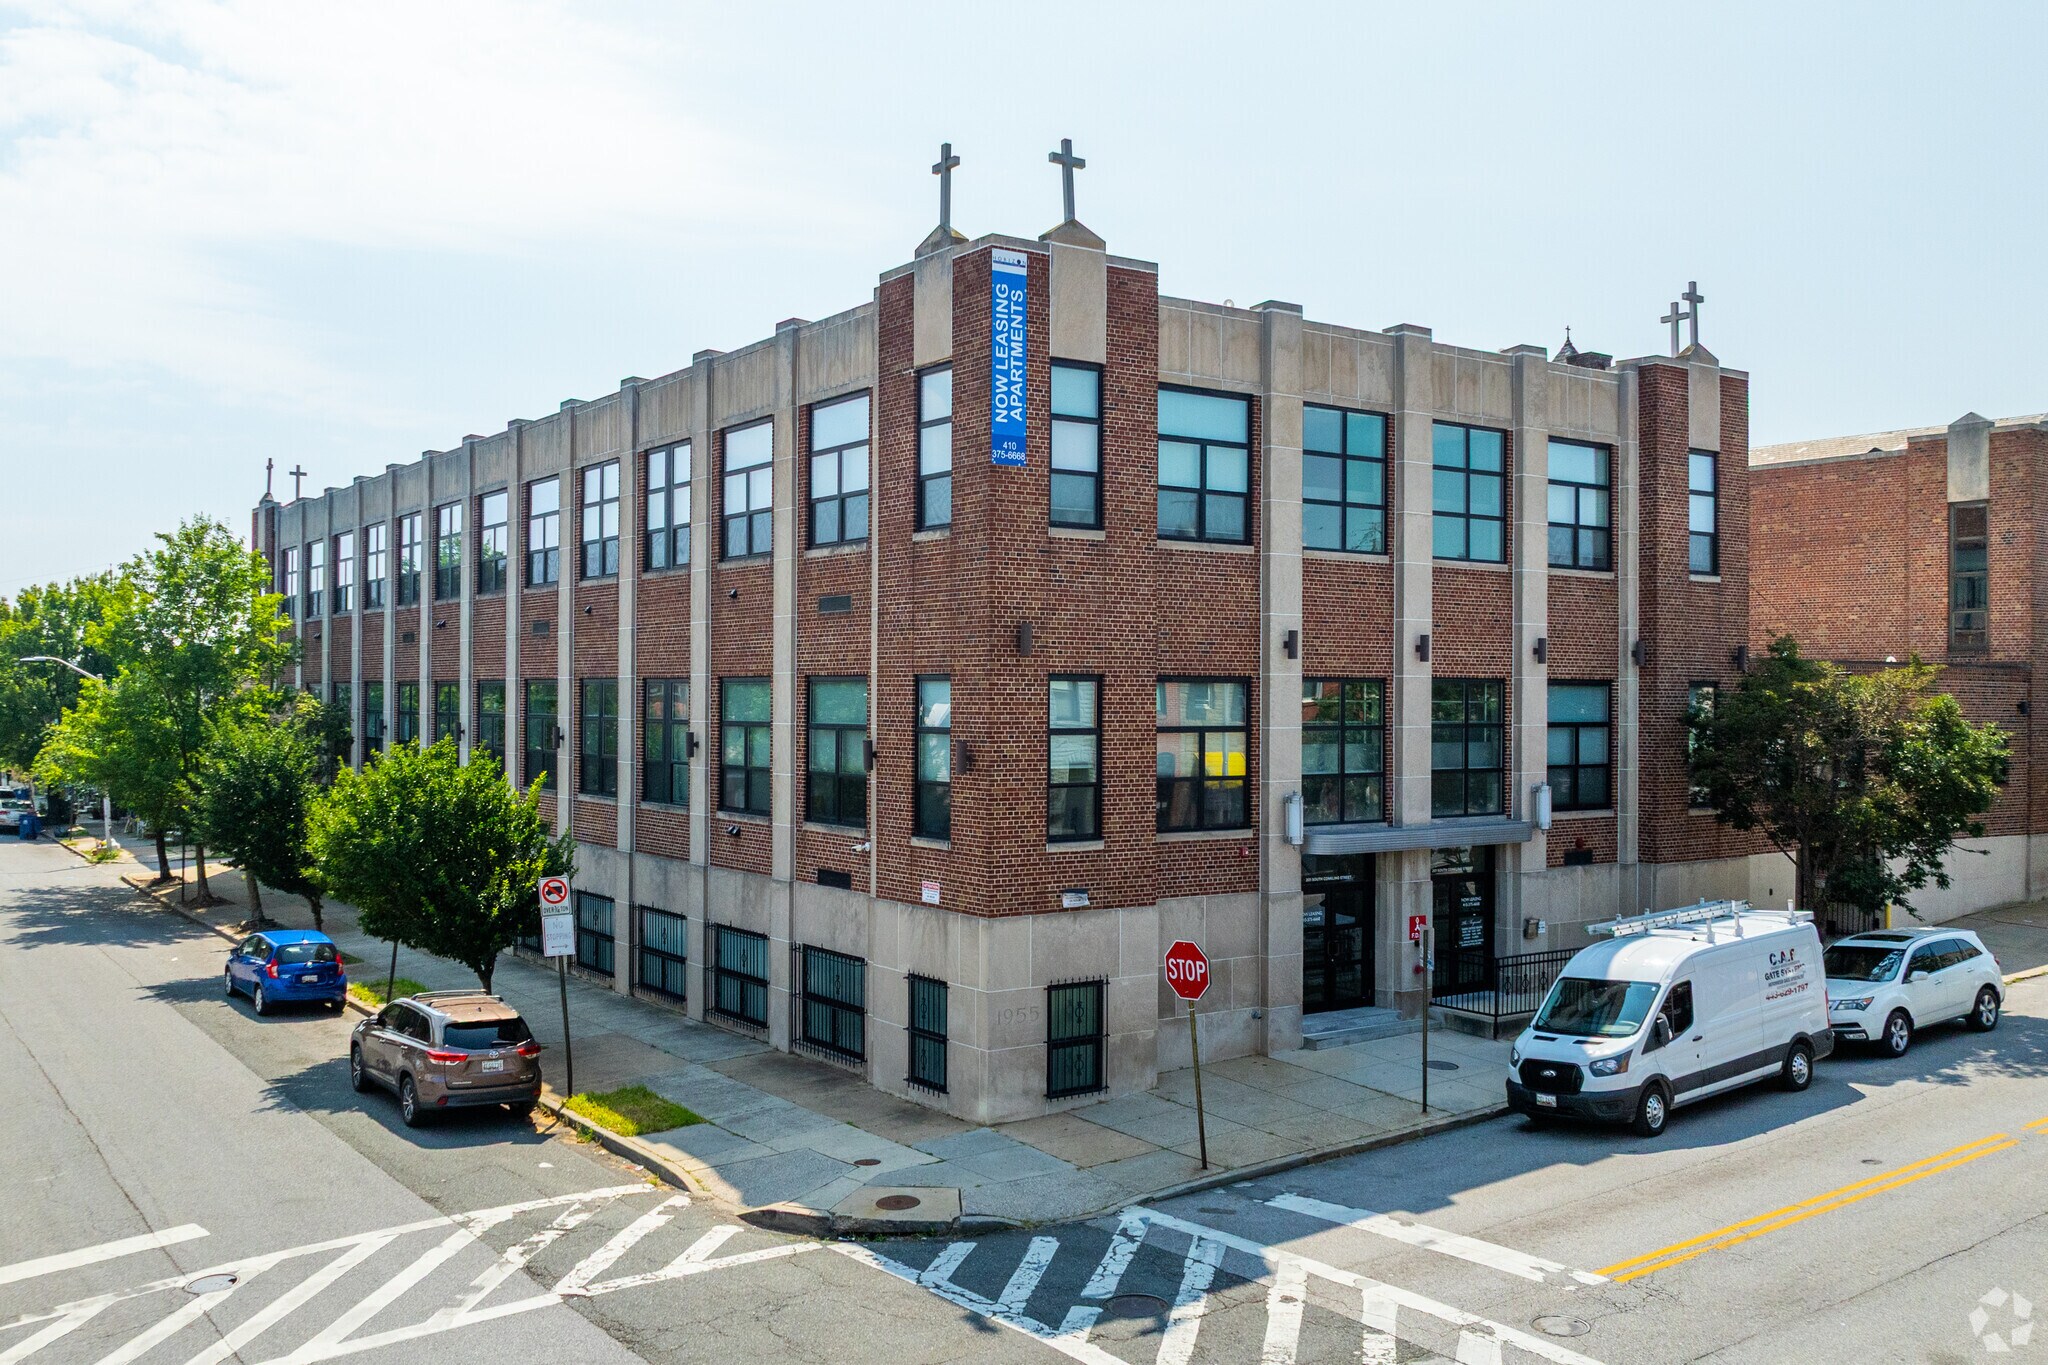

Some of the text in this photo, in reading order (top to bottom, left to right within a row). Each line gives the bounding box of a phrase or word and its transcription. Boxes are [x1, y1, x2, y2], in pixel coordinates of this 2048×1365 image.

[995, 283, 1009, 423] NOW LEASING
[1010, 289, 1023, 421] APARTMENTS
[1003, 441, 1017, 450] 410
[992, 449, 1025, 460] 375-6668
[552, 921, 564, 930] NO
[1168, 957, 1206, 982] STOP
[1764, 970, 1780, 981] GATE
[997, 1006, 1040, 1026] 1955
